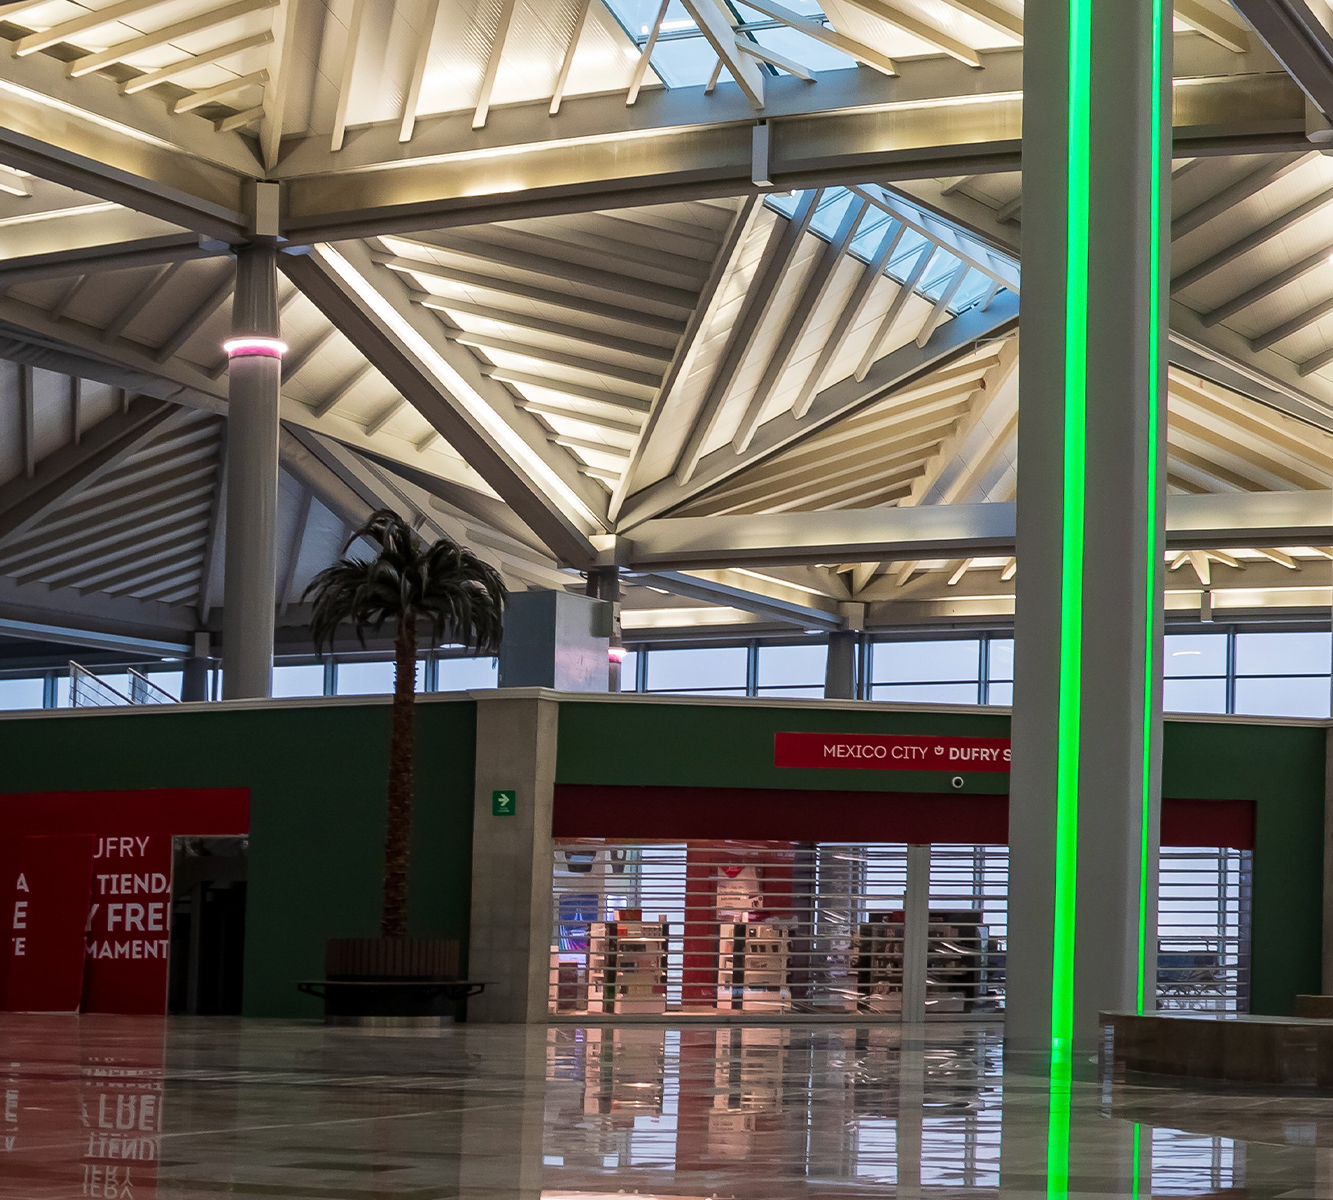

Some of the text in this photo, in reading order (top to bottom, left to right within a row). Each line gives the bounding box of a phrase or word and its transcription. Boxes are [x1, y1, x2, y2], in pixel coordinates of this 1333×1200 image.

[823, 744, 887, 759] MEXICO
[891, 746, 928, 760] CITY
[949, 747, 999, 761] DUFRY
[97, 873, 172, 895] TIEND
[107, 902, 172, 932] FRE
[12, 937, 26, 956] E
